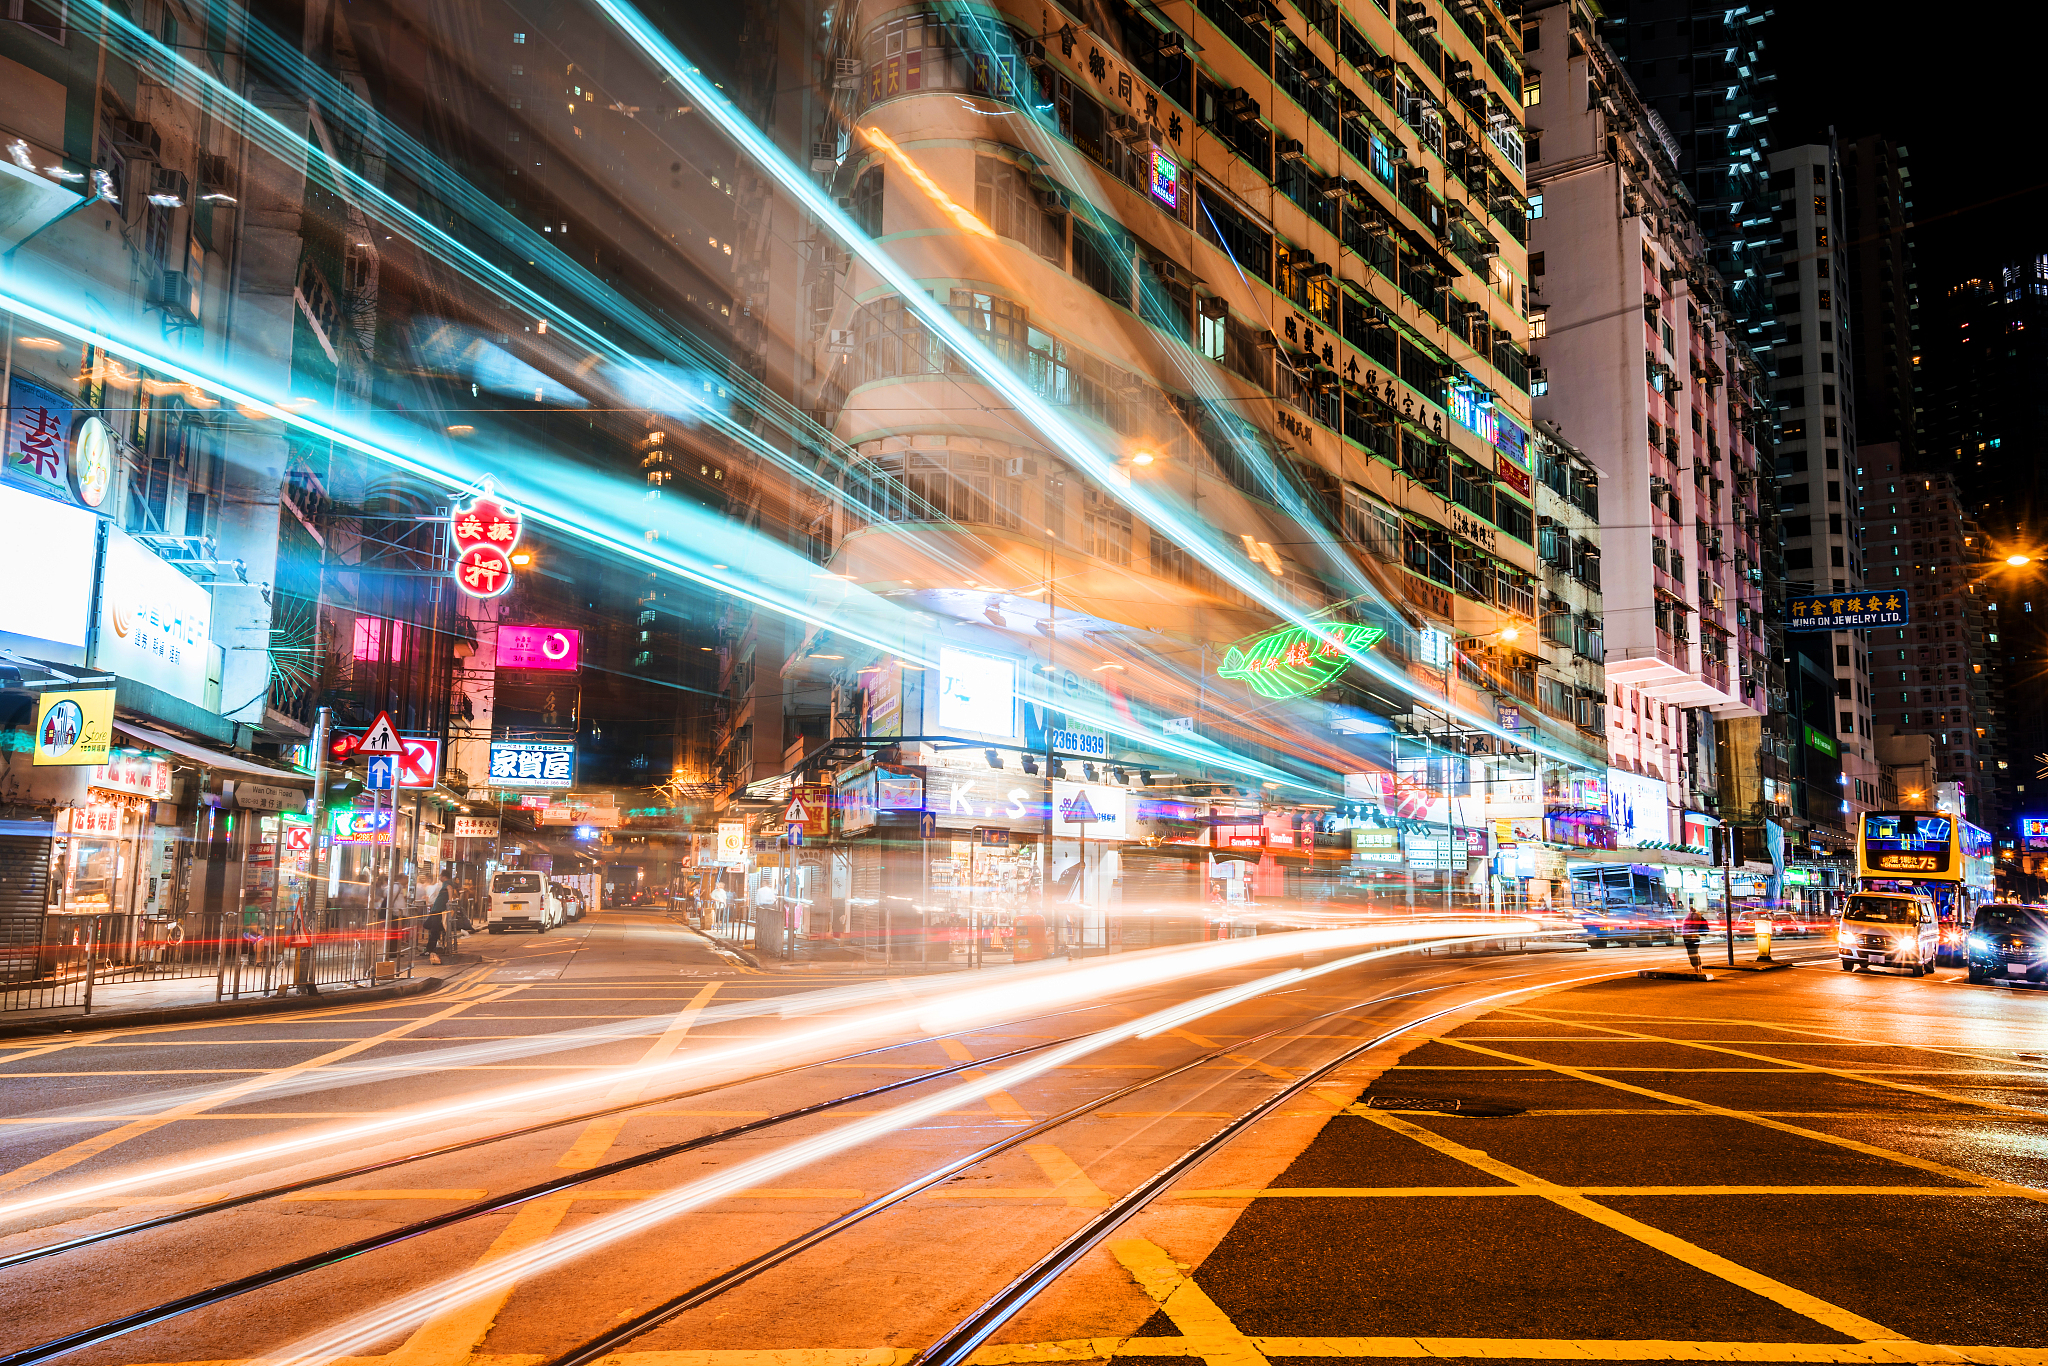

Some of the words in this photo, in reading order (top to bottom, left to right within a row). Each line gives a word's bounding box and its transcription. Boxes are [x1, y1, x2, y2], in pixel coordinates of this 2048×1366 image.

[17, 405, 62, 479] 素
[464, 552, 503, 592] 押
[163, 602, 204, 648] CHIEF
[1793, 617, 1816, 627] WING
[1818, 616, 1830, 626] ON
[1833, 613, 1877, 625] JEWELRY
[1881, 612, 1902, 622] LTD.
[81, 720, 108, 744] Store
[1052, 729, 1078, 751] 2366
[1079, 732, 1104, 755] 3939
[491, 749, 570, 779] 家賀屋
[253, 785, 265, 794] Wan
[279, 789, 292, 798] Road
[260, 798, 282, 809] 灣仔道
[292, 830, 310, 847] K
[1919, 856, 1937, 870] 75
